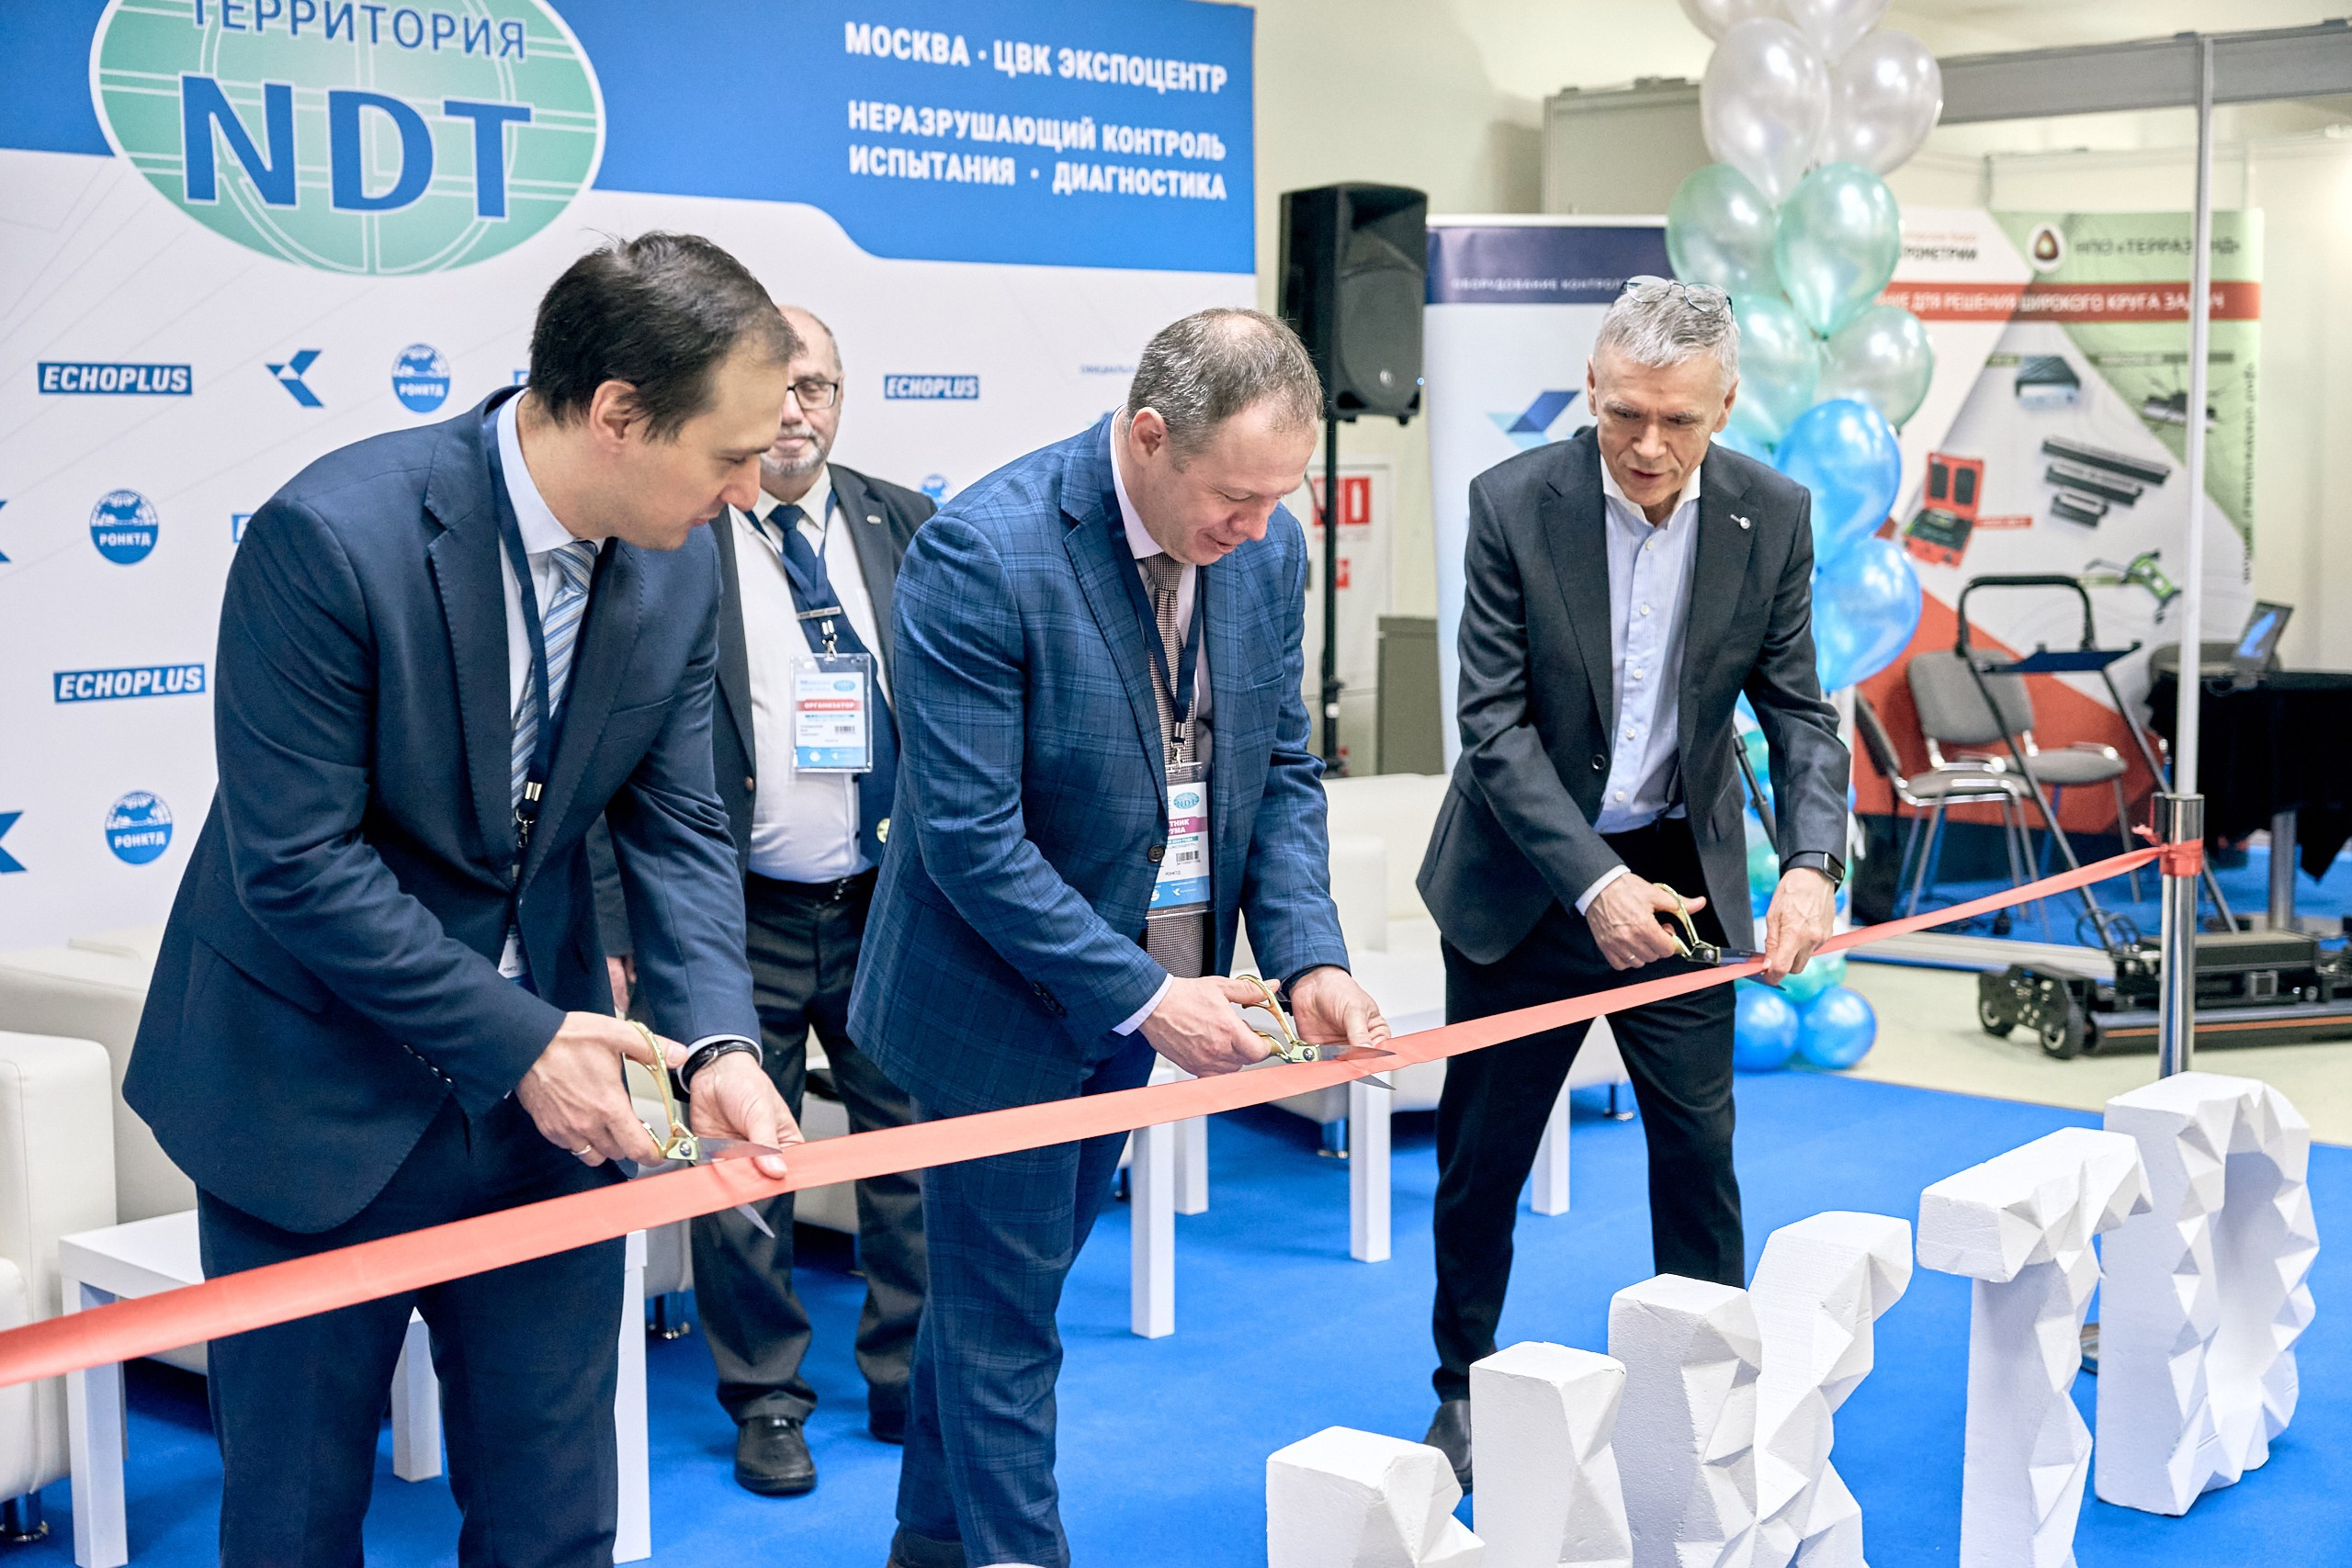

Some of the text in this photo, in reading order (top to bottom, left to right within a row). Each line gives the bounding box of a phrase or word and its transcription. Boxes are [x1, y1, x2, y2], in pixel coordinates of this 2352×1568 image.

[844, 21, 1227, 95] МОСКВА ЦВК ЭКСПОЦЕНТР
[182, 75, 532, 220] NDT
[848, 99, 1227, 162] НЕРАЗРУШАЮЩИЙ КОНТРОЛЬ
[849, 143, 1228, 201] ИСПЫТАНИЯ ДИАГНОСТИКА
[42, 365, 188, 393] ECHOPLUS
[886, 376, 978, 398] ECHOPLUS
[98, 532, 152, 548] РОНКТД
[58, 666, 203, 701] ECHOPLUS
[114, 829, 166, 850] РОНКТД
